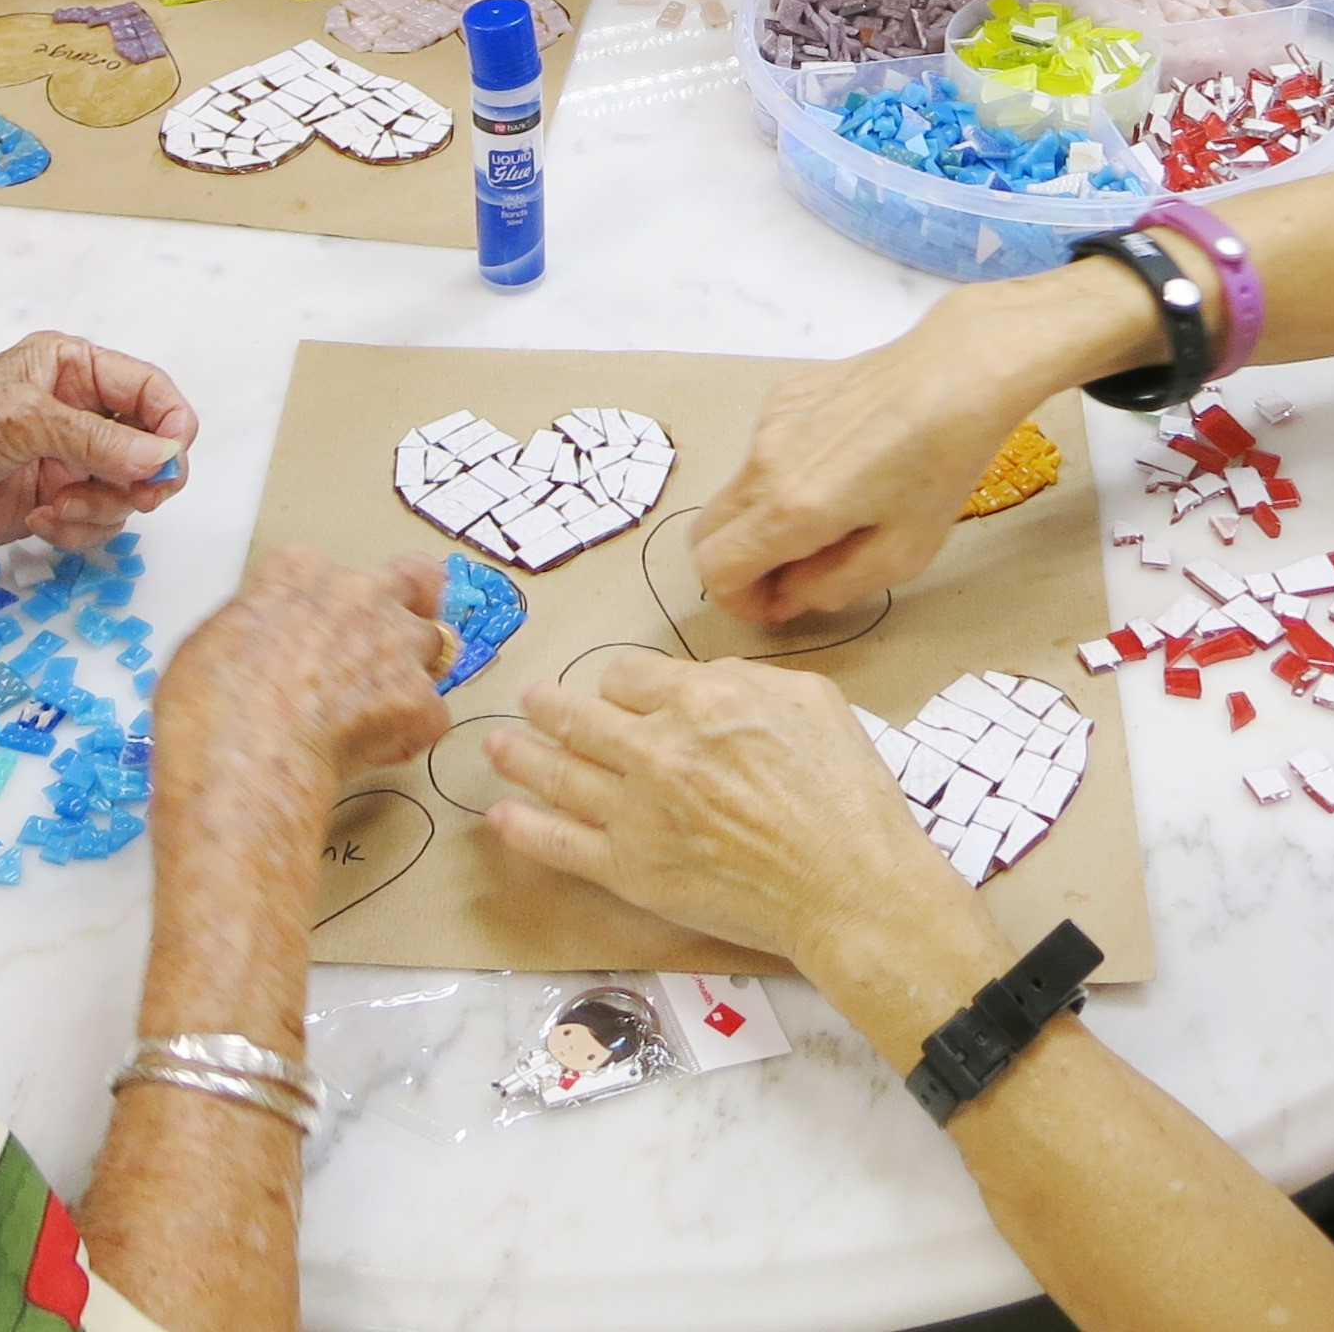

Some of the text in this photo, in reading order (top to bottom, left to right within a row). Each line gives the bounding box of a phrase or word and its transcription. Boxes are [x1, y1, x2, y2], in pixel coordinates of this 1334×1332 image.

[33, 43, 122, 70] orange
[491, 151, 532, 165] LIQUID
[490, 166, 532, 184] Glue
[320, 840, 366, 865] nk
